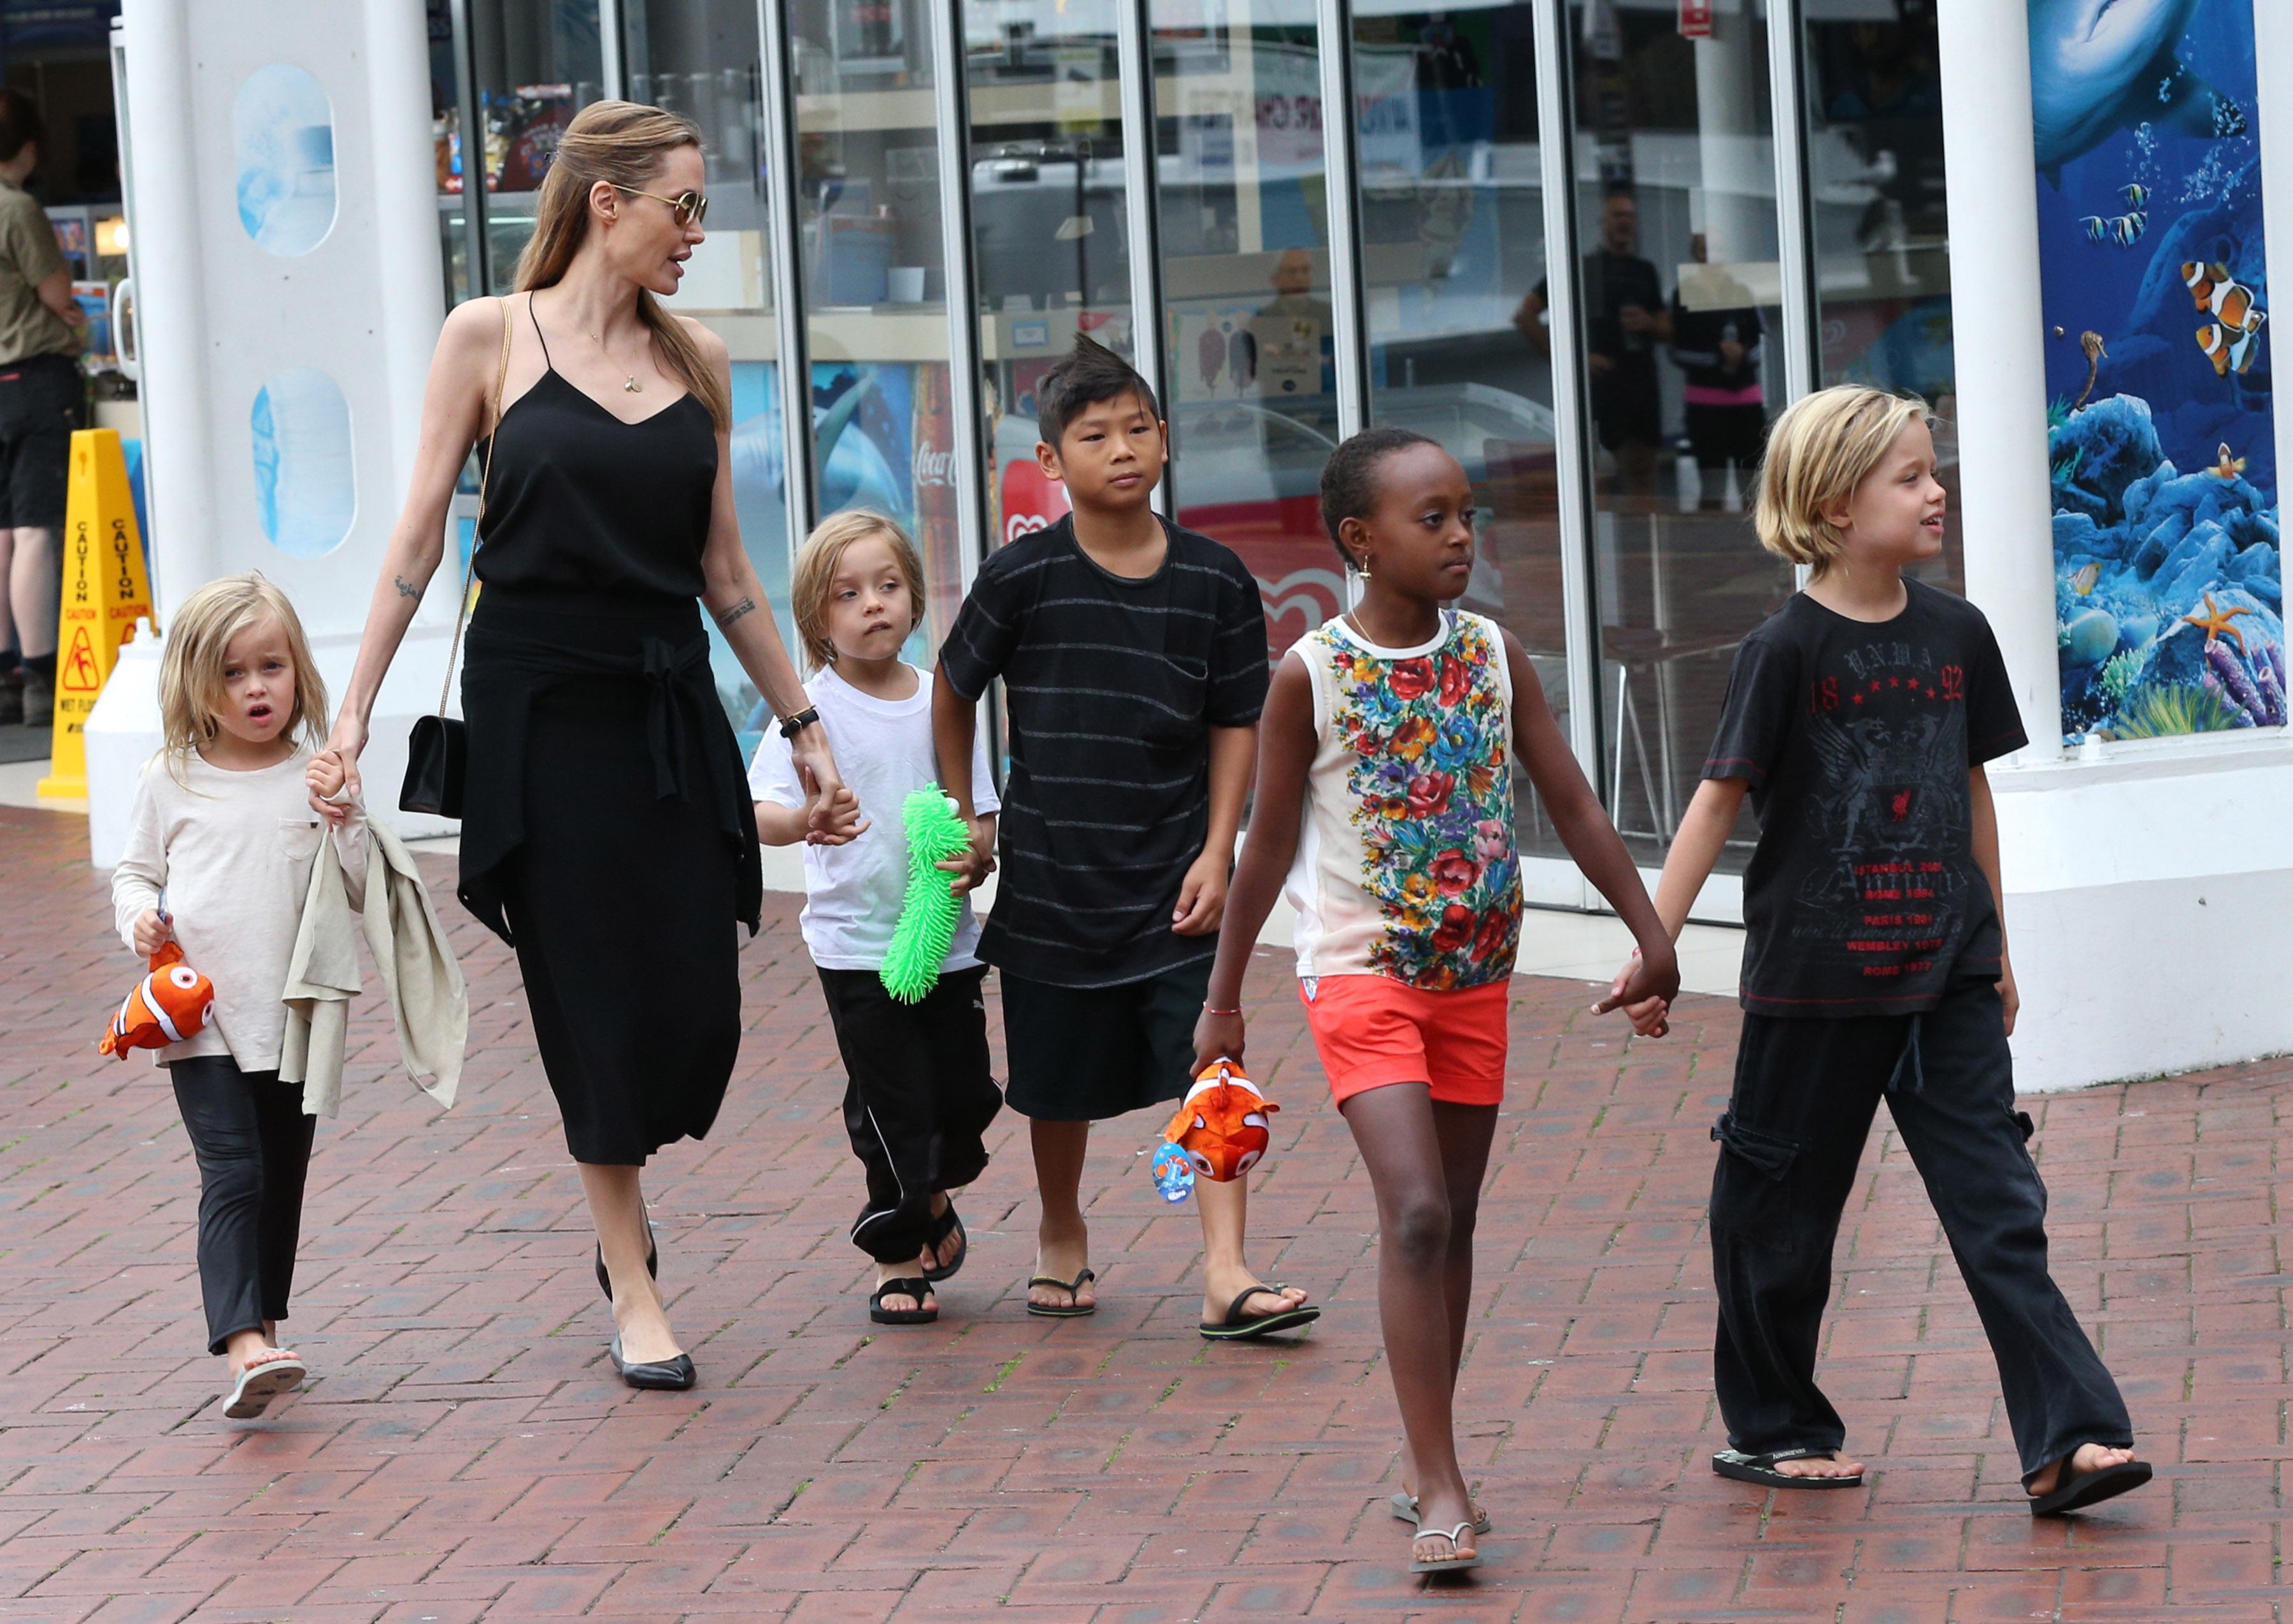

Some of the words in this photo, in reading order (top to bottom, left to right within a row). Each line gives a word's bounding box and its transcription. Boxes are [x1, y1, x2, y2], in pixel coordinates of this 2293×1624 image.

[76, 522, 88, 602] CAUTION
[111, 518, 134, 600] CAUTION
[67, 608, 96, 620] CAUTION
[109, 604, 148, 619] CAUTION
[1809, 675, 1841, 715] 18
[1938, 664, 1964, 702] 92
[1854, 862, 1916, 877] ISTANBUL
[1864, 888, 1903, 901] ROME
[1863, 914, 1903, 927] PARIS
[1845, 939, 1911, 952] WEMBLEY
[1862, 965, 1901, 978] ROME
[1903, 961, 1933, 973] 1977
